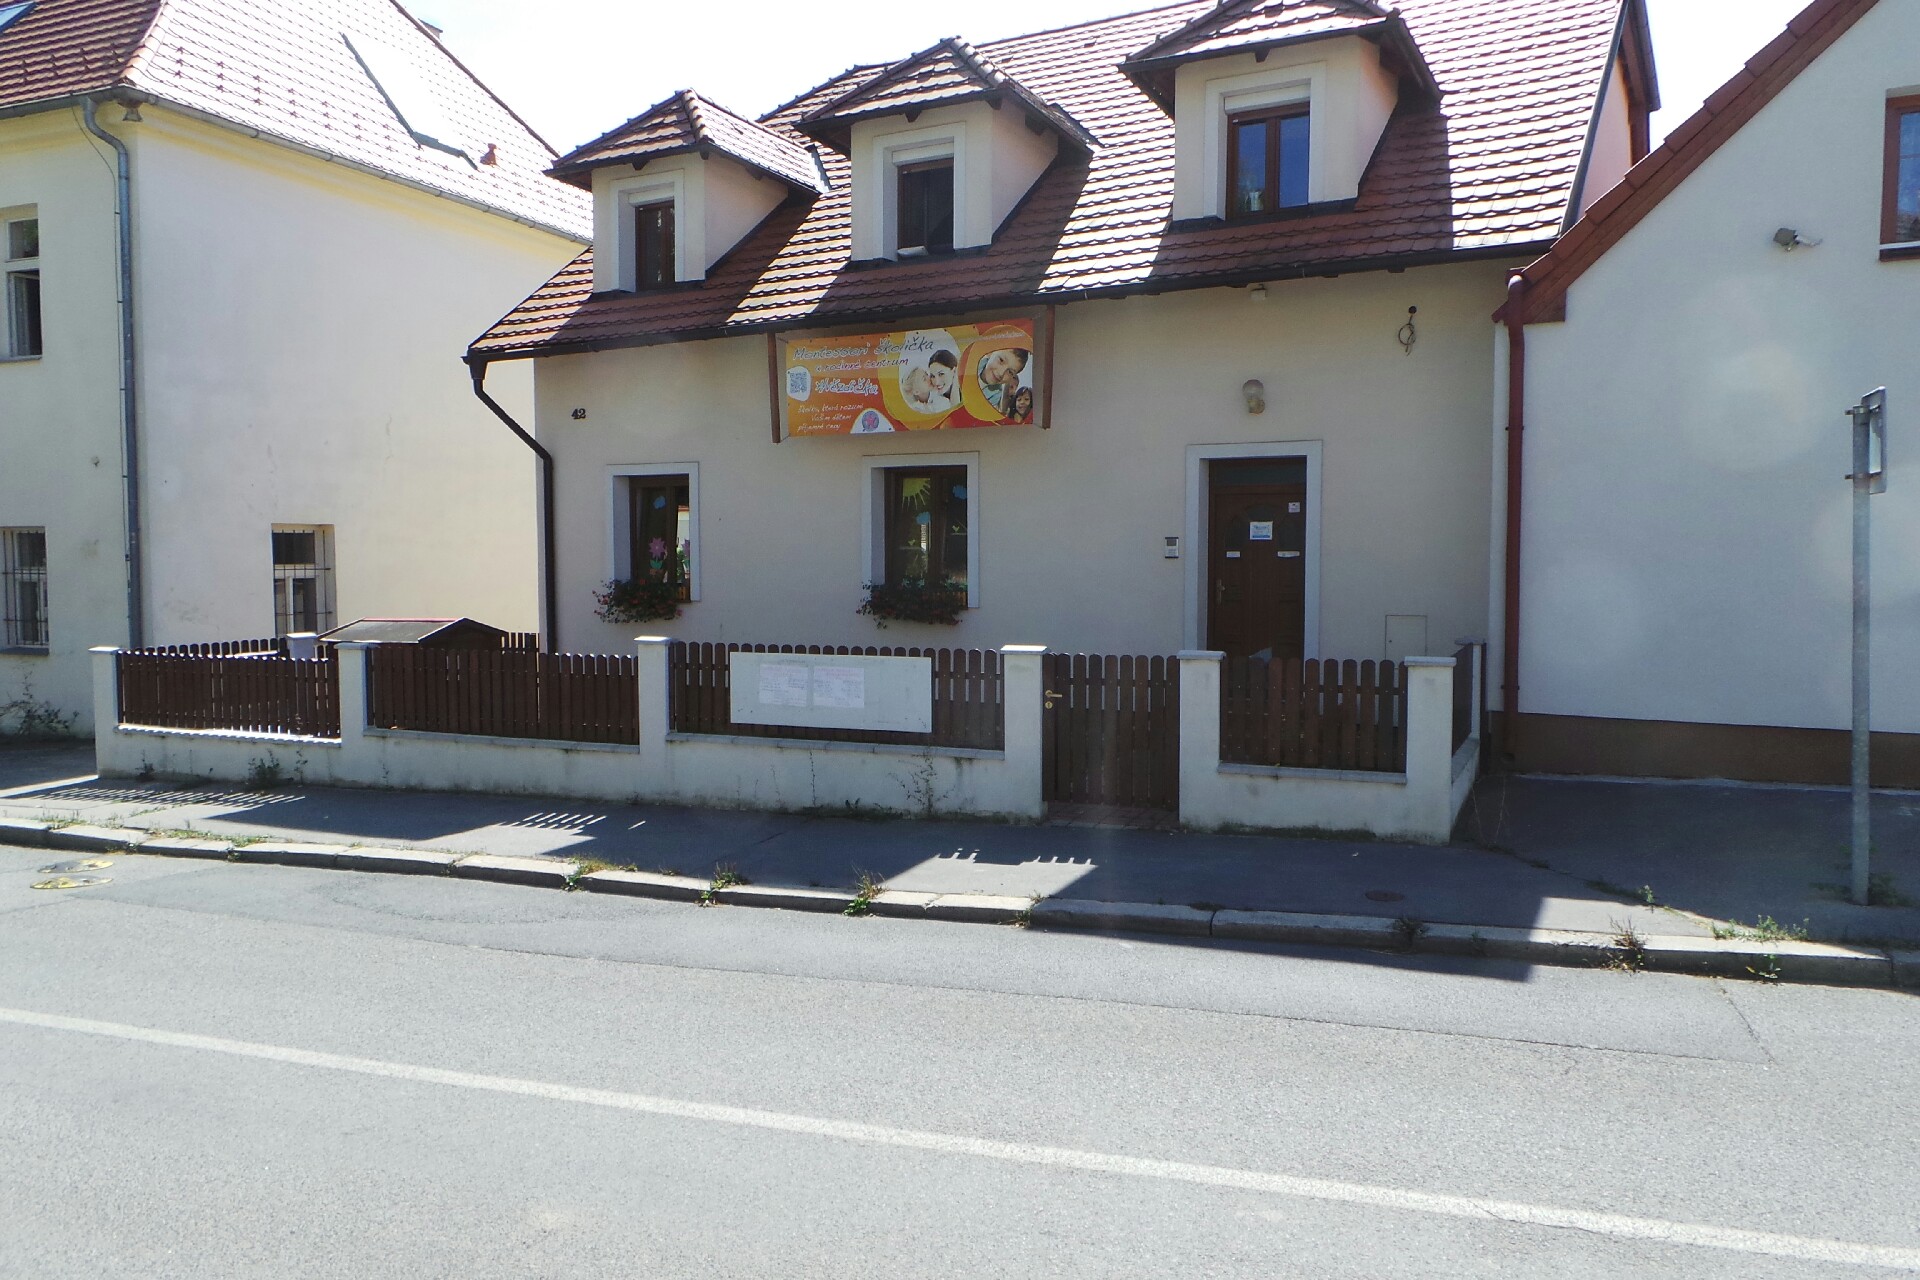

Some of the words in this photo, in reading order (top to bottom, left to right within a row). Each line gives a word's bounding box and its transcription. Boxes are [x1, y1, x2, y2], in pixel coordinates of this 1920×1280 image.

[874, 336, 934, 355] Školička
[823, 359, 862, 372] rodinné
[863, 356, 909, 369] centrum
[571, 408, 586, 419] 42
